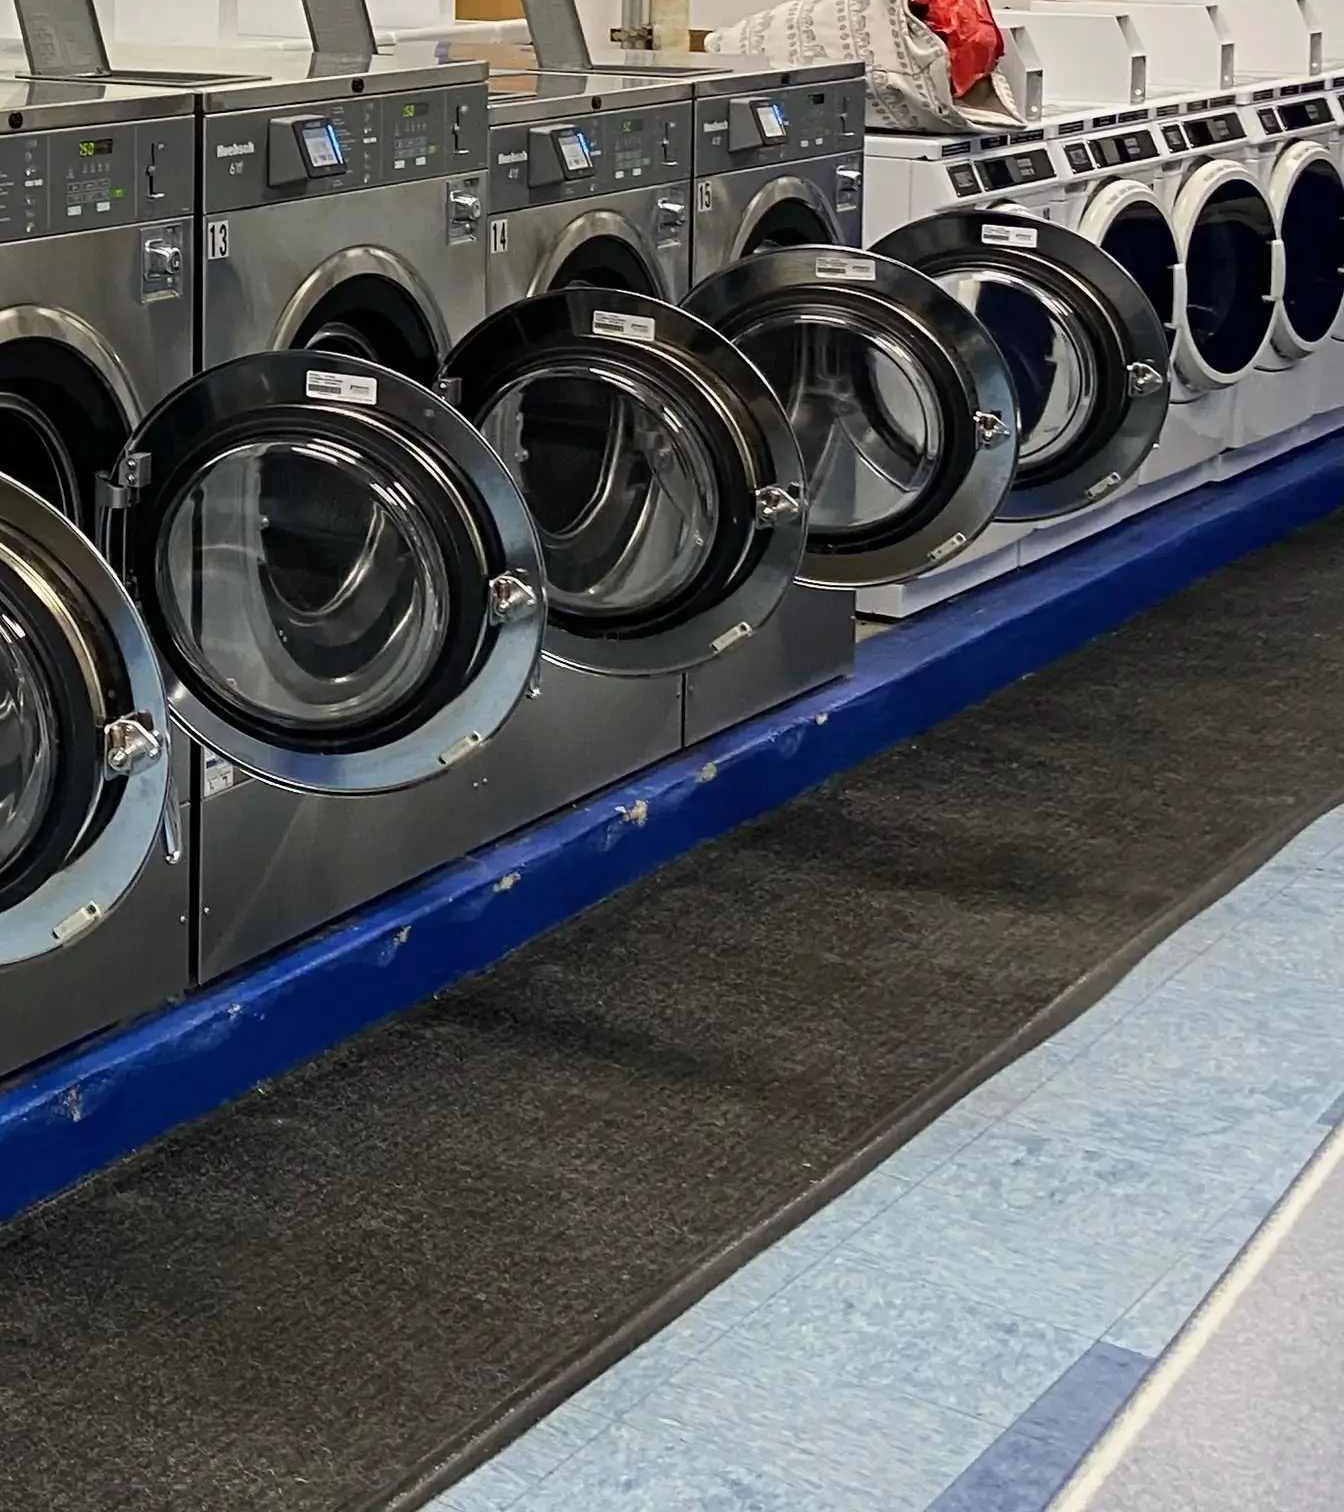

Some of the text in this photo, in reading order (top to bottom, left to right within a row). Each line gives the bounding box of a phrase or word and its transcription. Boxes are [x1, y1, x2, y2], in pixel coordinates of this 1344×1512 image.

[216, 141, 255, 158] Huebsch
[699, 182, 712, 211] 15
[209, 224, 228, 258] 13
[491, 222, 507, 252] 14
